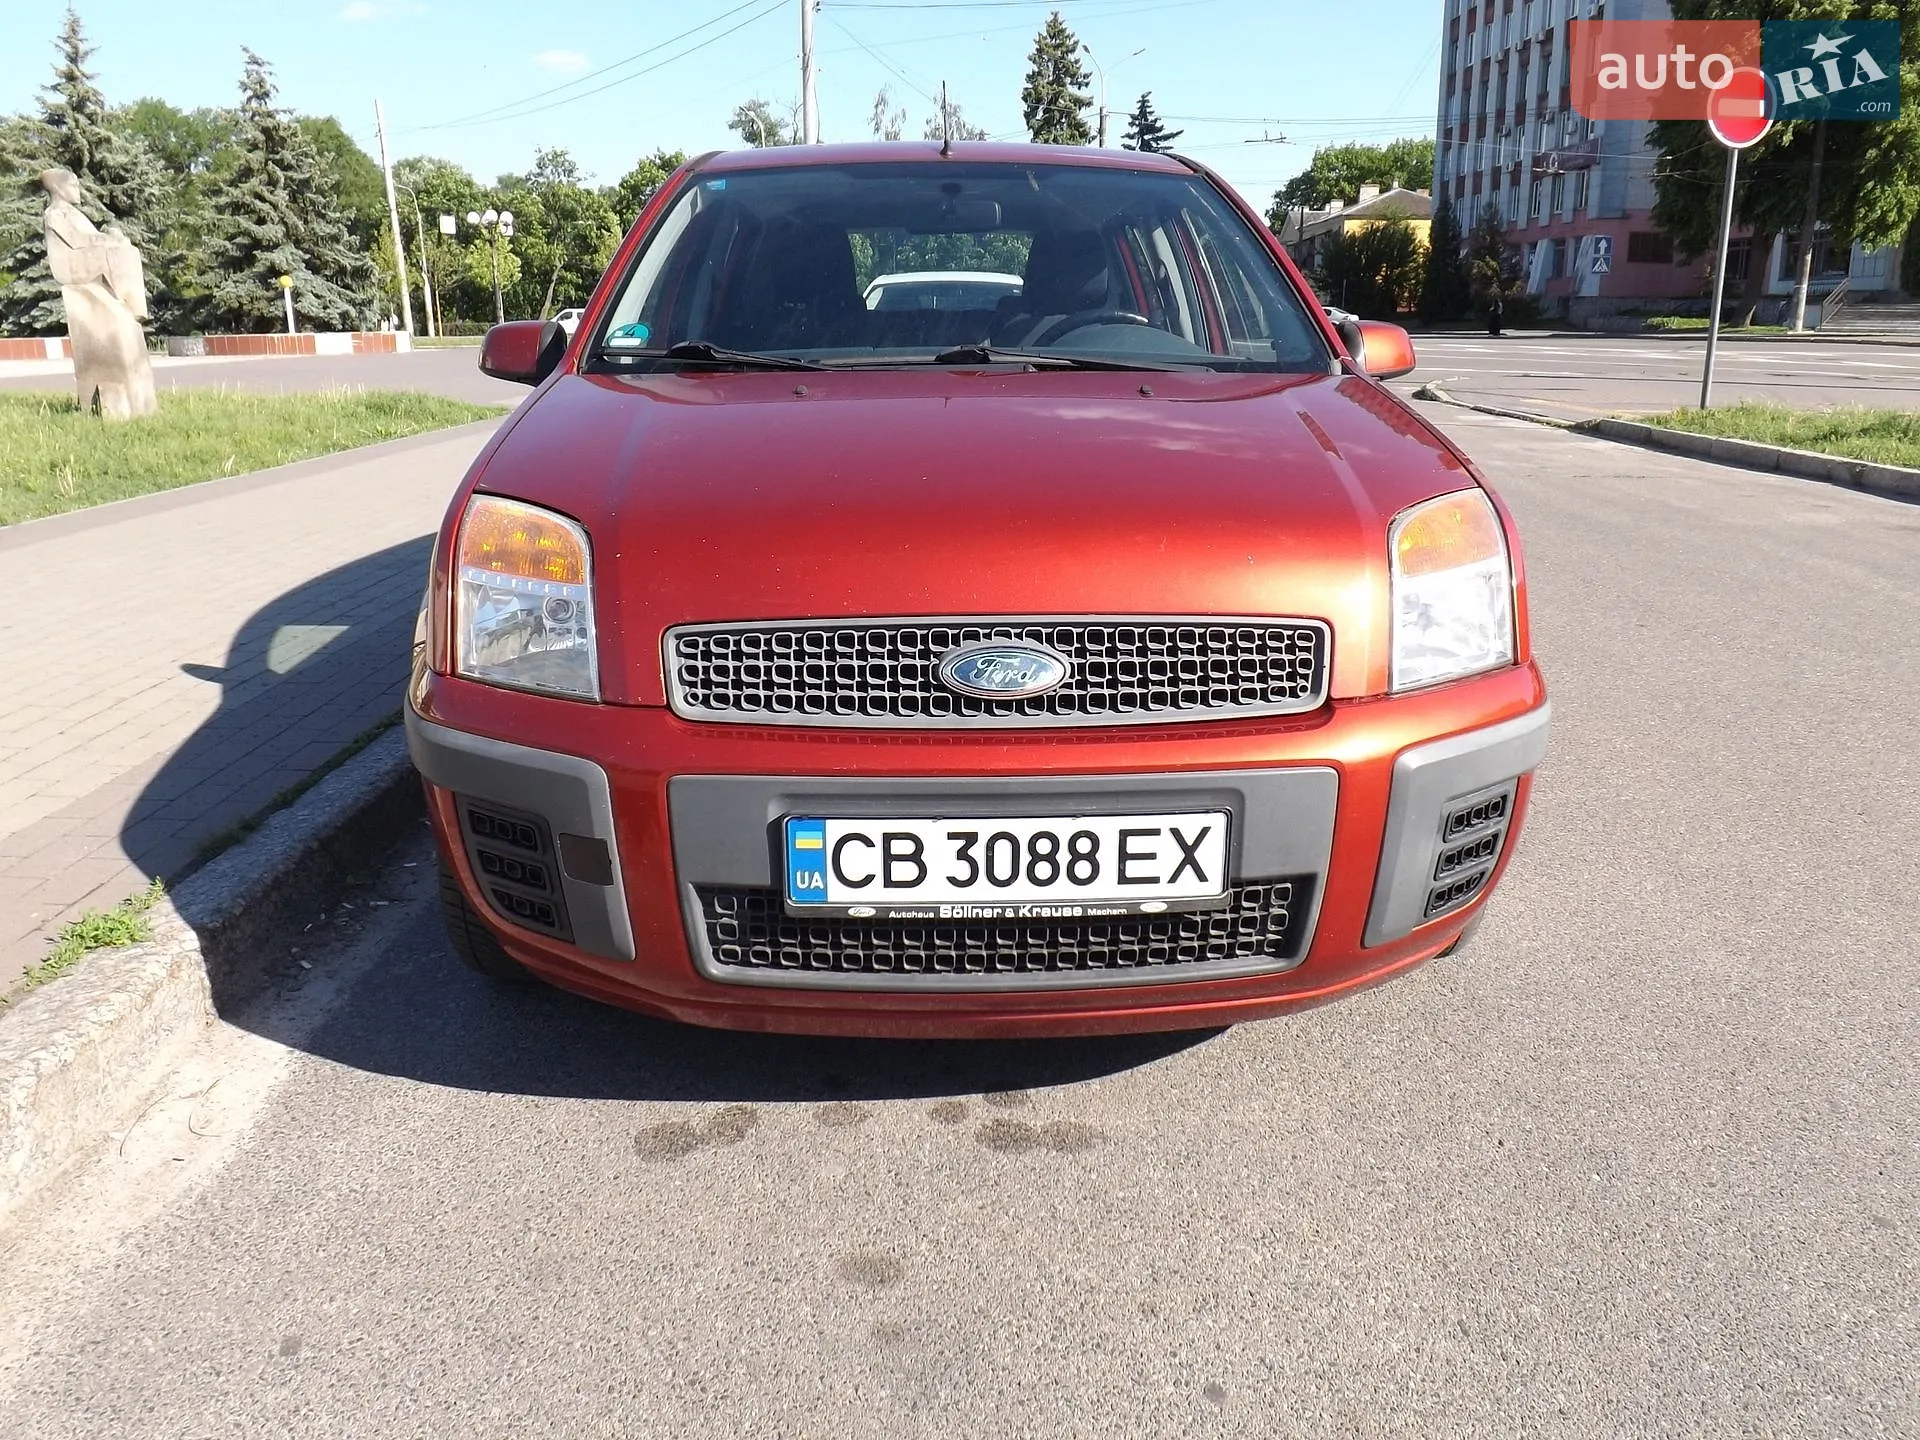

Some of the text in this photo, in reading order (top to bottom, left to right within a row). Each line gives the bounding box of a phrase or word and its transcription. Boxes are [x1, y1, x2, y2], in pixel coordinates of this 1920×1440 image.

[969, 655, 1037, 684] Ford
[831, 826, 1212, 889] CB 3088 EX
[796, 870, 824, 889] UA
[888, 910, 935, 919] Autohaus
[939, 905, 1003, 919] Söllner
[1004, 907, 1015, 918] &
[1018, 905, 1083, 918] Krause
